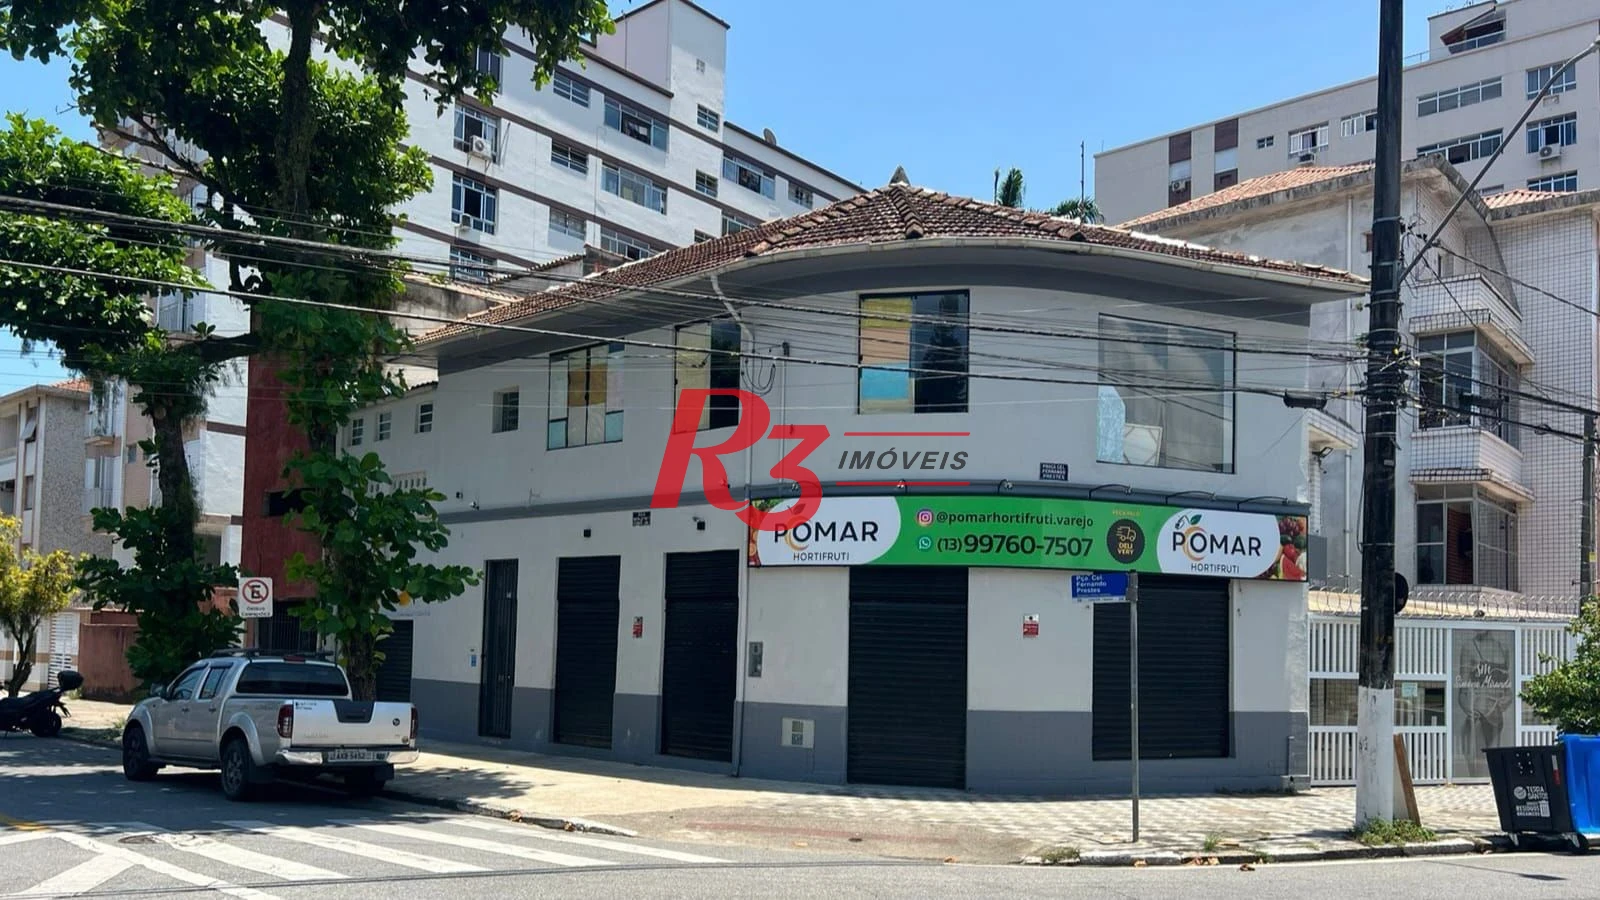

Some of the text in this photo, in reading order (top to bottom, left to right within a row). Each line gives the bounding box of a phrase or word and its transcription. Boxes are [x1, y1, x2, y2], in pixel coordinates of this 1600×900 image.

[936, 511, 1094, 529] @pomarhortifruti.varejo
[774, 521, 879, 543] POMAR
[1172, 531, 1262, 557] POMAR
[793, 552, 850, 561] HORTIFRUTI
[1191, 562, 1240, 574] HORTIFRUTI
